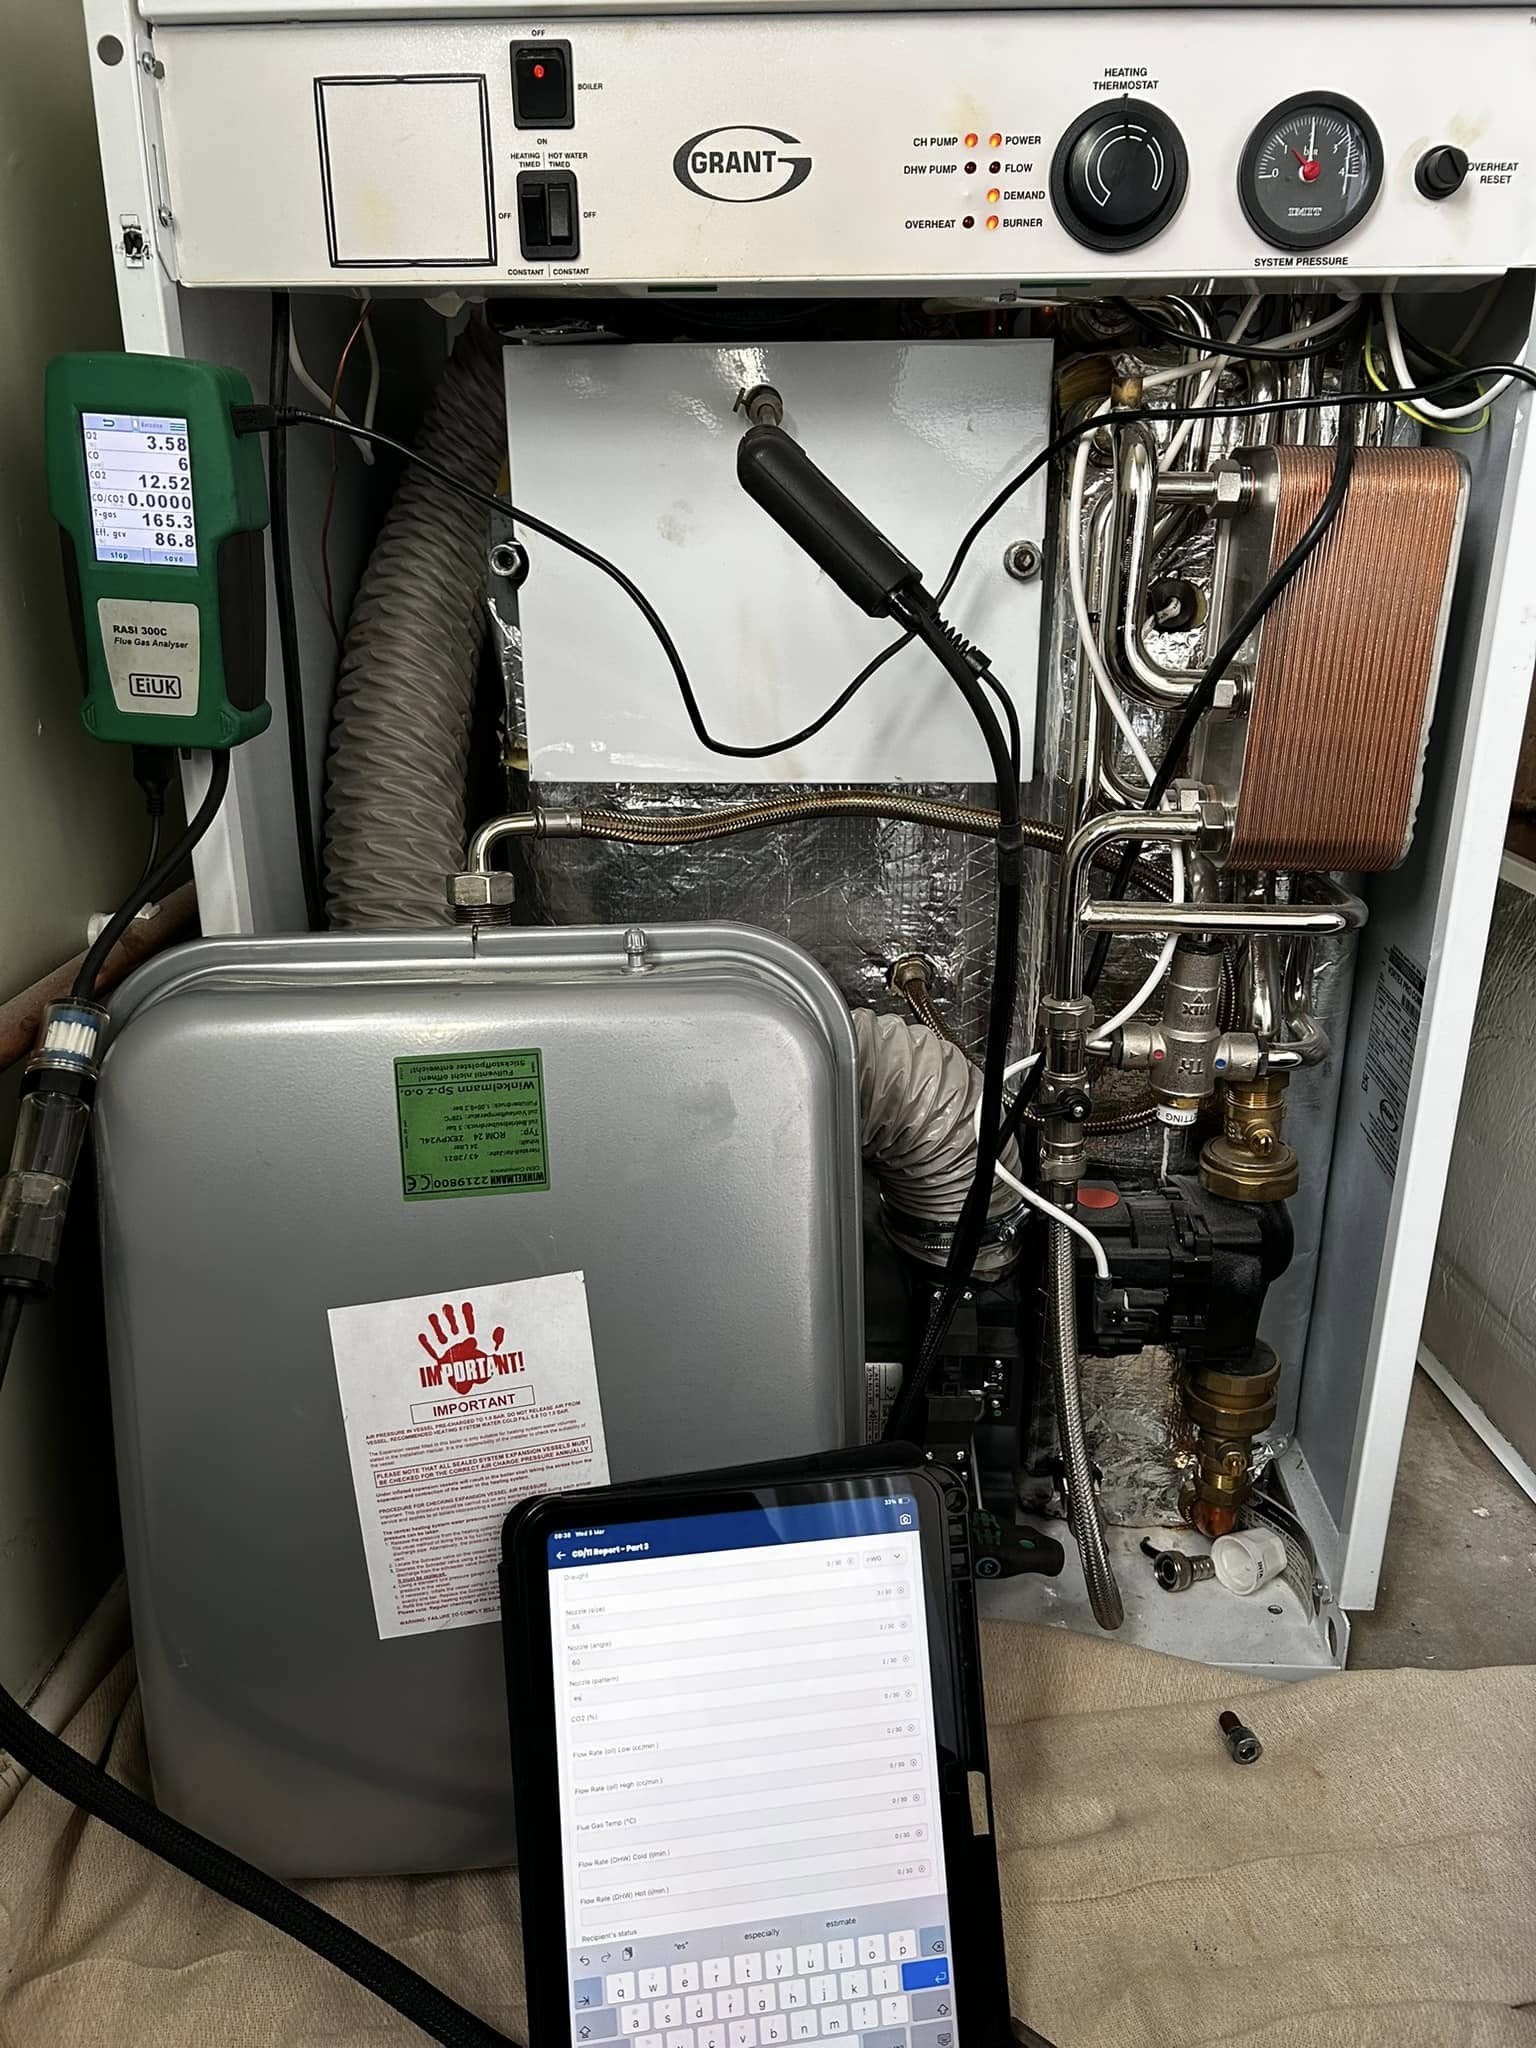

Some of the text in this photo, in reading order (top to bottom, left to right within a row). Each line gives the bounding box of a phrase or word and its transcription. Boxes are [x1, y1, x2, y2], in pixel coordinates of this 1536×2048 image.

[531, 29, 545, 37] OFF
[1104, 67, 1148, 77] HEATING
[577, 82, 603, 90] BOILER
[1092, 80, 1159, 90] THERMOSTAT
[913, 137, 959, 147] CH PUMP
[1005, 135, 1042, 145] POWER
[510, 152, 541, 160] HEATING
[691, 150, 777, 174] GRANT
[1467, 162, 1520, 172] OVERHEAT
[903, 164, 958, 175] DHW PUMP
[1004, 163, 1033, 173] FLOW
[1271, 168, 1279, 177] 0
[1479, 174, 1512, 184] RESET
[1003, 190, 1046, 200] DEMAND
[498, 212, 512, 220] OFF
[583, 211, 597, 219] OFF
[904, 219, 957, 229] OVERHEAT
[1002, 218, 1043, 228] BURNER
[1254, 256, 1349, 267] SYSTEM PRESSURE
[507, 268, 544, 276] CONSTANT
[552, 267, 590, 275] CONSTANT
[85, 431, 97, 440] O2
[146, 435, 187, 452] 3.58
[87, 451, 99, 460] CO
[178, 457, 188, 471] 6
[89, 470, 106, 480] CO2
[139, 474, 190, 491] 12.52
[92, 493, 125, 504] CO/CO2
[127, 492, 192, 510] 0.0000
[94, 508, 117, 520] T-gas
[142, 513, 193, 529] 165.3
[155, 532, 194, 548] 86.8
[110, 551, 129, 560] stop
[164, 555, 184, 563] save
[113, 625, 168, 636] RASI 300C
[114, 636, 189, 650] Flue Gas Analyser
[135, 678, 177, 695] EiUK
[450, 1071, 472, 1079] nicht
[457, 1080, 534, 1094] Winkelmann
[473, 1132, 483, 1140] 24
[520, 1126, 538, 1137] Typ:
[433, 1175, 488, 1188] 2219800
[418, 1351, 525, 1388] IMPORTANT!
[432, 1393, 516, 1417] IMPORTANT
[375, 1429, 405, 1438] PRESSURE
[412, 1424, 433, 1432] VESSEL
[528, 1405, 553, 1413] RELEASE
[390, 1431, 433, 1442] RECOMMENDED
[433, 1426, 457, 1435] HEATING
[481, 1419, 501, 1427] WATER
[376, 1470, 400, 1479] PLEASE
[402, 1467, 419, 1475] NOTE
[421, 1464, 437, 1472] THAT
[452, 1458, 477, 1467] SEALED
[478, 1453, 504, 1463] SYSTEM
[505, 1447, 541, 1458] EXPANSION
[542, 1442, 570, 1452] VESSELS
[571, 1439, 589, 1447] MUST
[388, 1474, 420, 1483] CHECKED
[448, 1464, 479, 1474] CORRECT
[492, 1457, 519, 1466] CHARGE
[520, 1452, 554, 1462] PRESSURE
[554, 1445, 588, 1456] ANNUALLY
[378, 1504, 412, 1514] PROCEDURE
[425, 1498, 453, 1506] CHECKING
[454, 1493, 486, 1502] EXPANSION
[519, 1482, 547, 1491] PRESSURE
[593, 1546, 620, 1557] Report
[626, 1543, 643, 1552] Part
[572, 1749, 587, 1759] Flow
[574, 1786, 589, 1795] Flow
[590, 1820, 603, 1829] Gas
[604, 1818, 622, 1828] Temp
[578, 1859, 592, 1868] Flow
[594, 1857, 608, 1866] Rate
[632, 1852, 647, 1860] Cold
[580, 1896, 594, 1905] Flow
[596, 1894, 610, 1903] Rate
[617, 1929, 637, 1938] status
[744, 1917, 857, 1941] especially estimate
